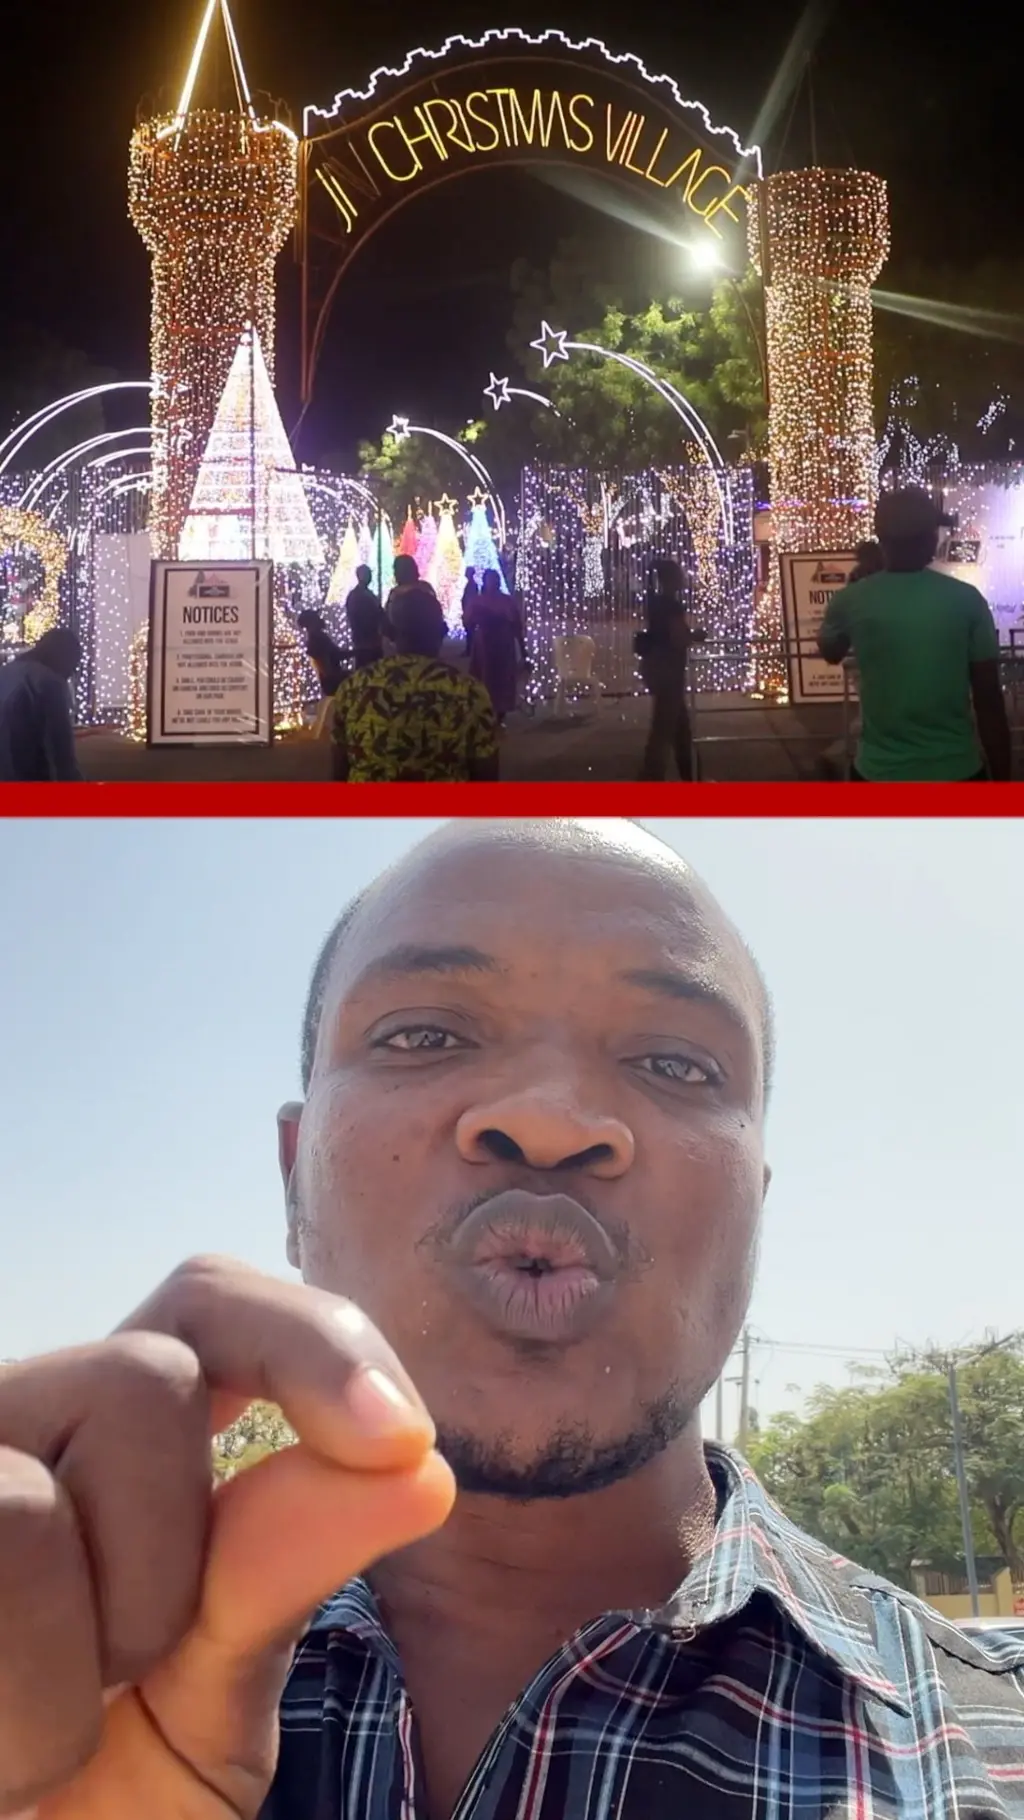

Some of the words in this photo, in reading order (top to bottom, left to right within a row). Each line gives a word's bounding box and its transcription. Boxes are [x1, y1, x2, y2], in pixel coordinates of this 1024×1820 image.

[367, 88, 595, 181] CHRISTMAS
[606, 103, 753, 240] VILLAGE
[182, 605, 239, 624] NOTICES
